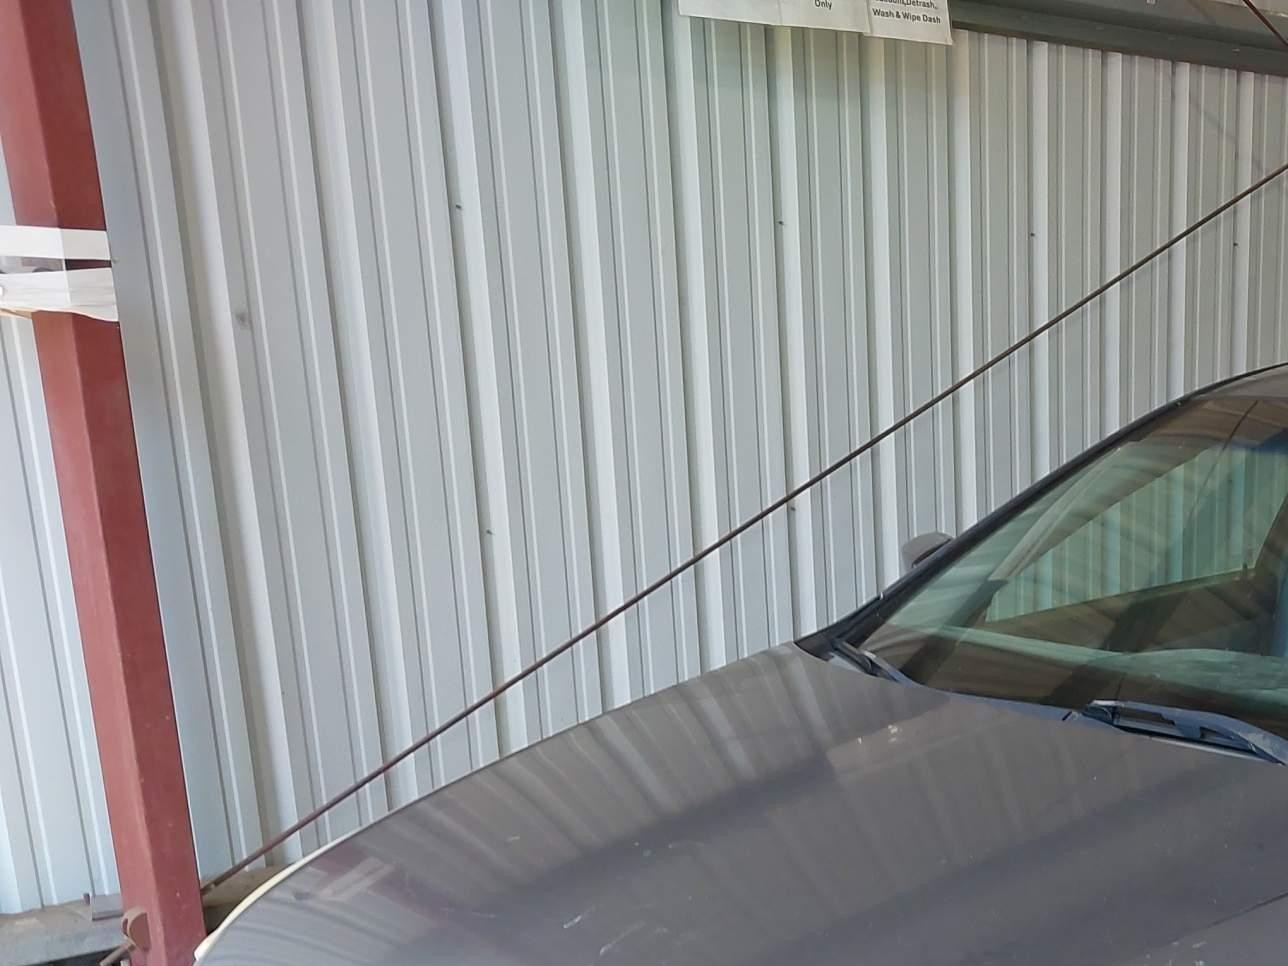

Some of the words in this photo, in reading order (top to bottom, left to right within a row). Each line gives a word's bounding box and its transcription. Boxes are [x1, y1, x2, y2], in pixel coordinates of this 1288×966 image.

[814, 0, 833, 10] Only
[872, 7, 895, 18] Wash
[895, 11, 901, 19] &
[901, 11, 921, 22] Wipe
[922, 14, 941, 24] Dash
